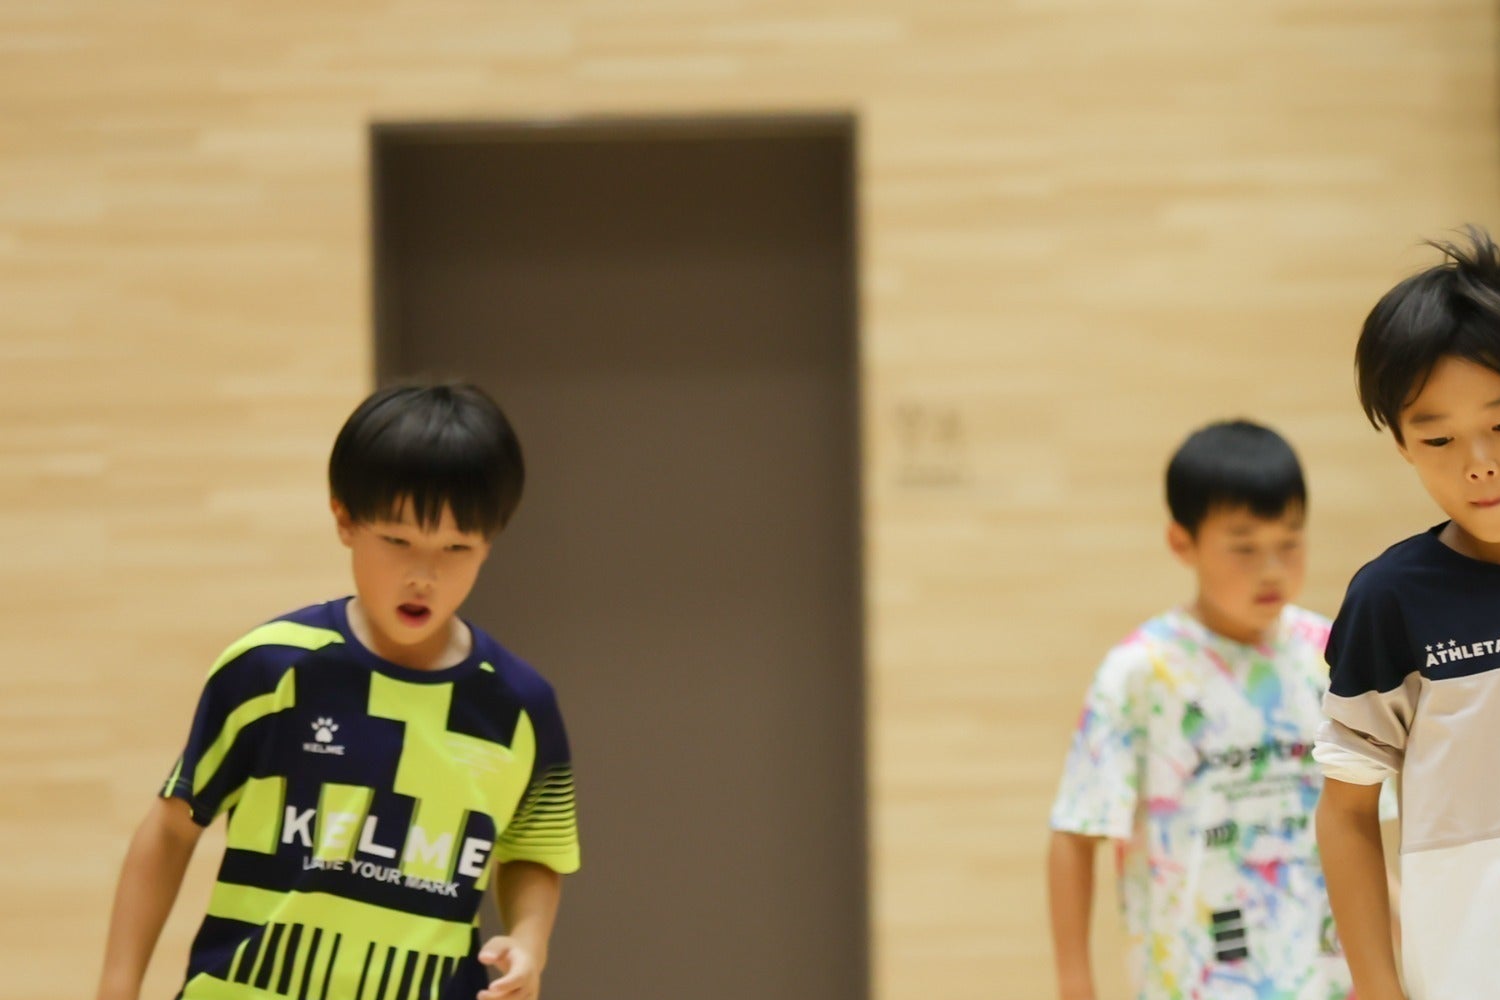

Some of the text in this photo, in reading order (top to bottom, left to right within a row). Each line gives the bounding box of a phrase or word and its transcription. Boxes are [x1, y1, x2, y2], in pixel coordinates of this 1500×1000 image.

[281, 805, 493, 878] KELME
[349, 858, 402, 886] YOUR
[404, 874, 459, 897] MARK
